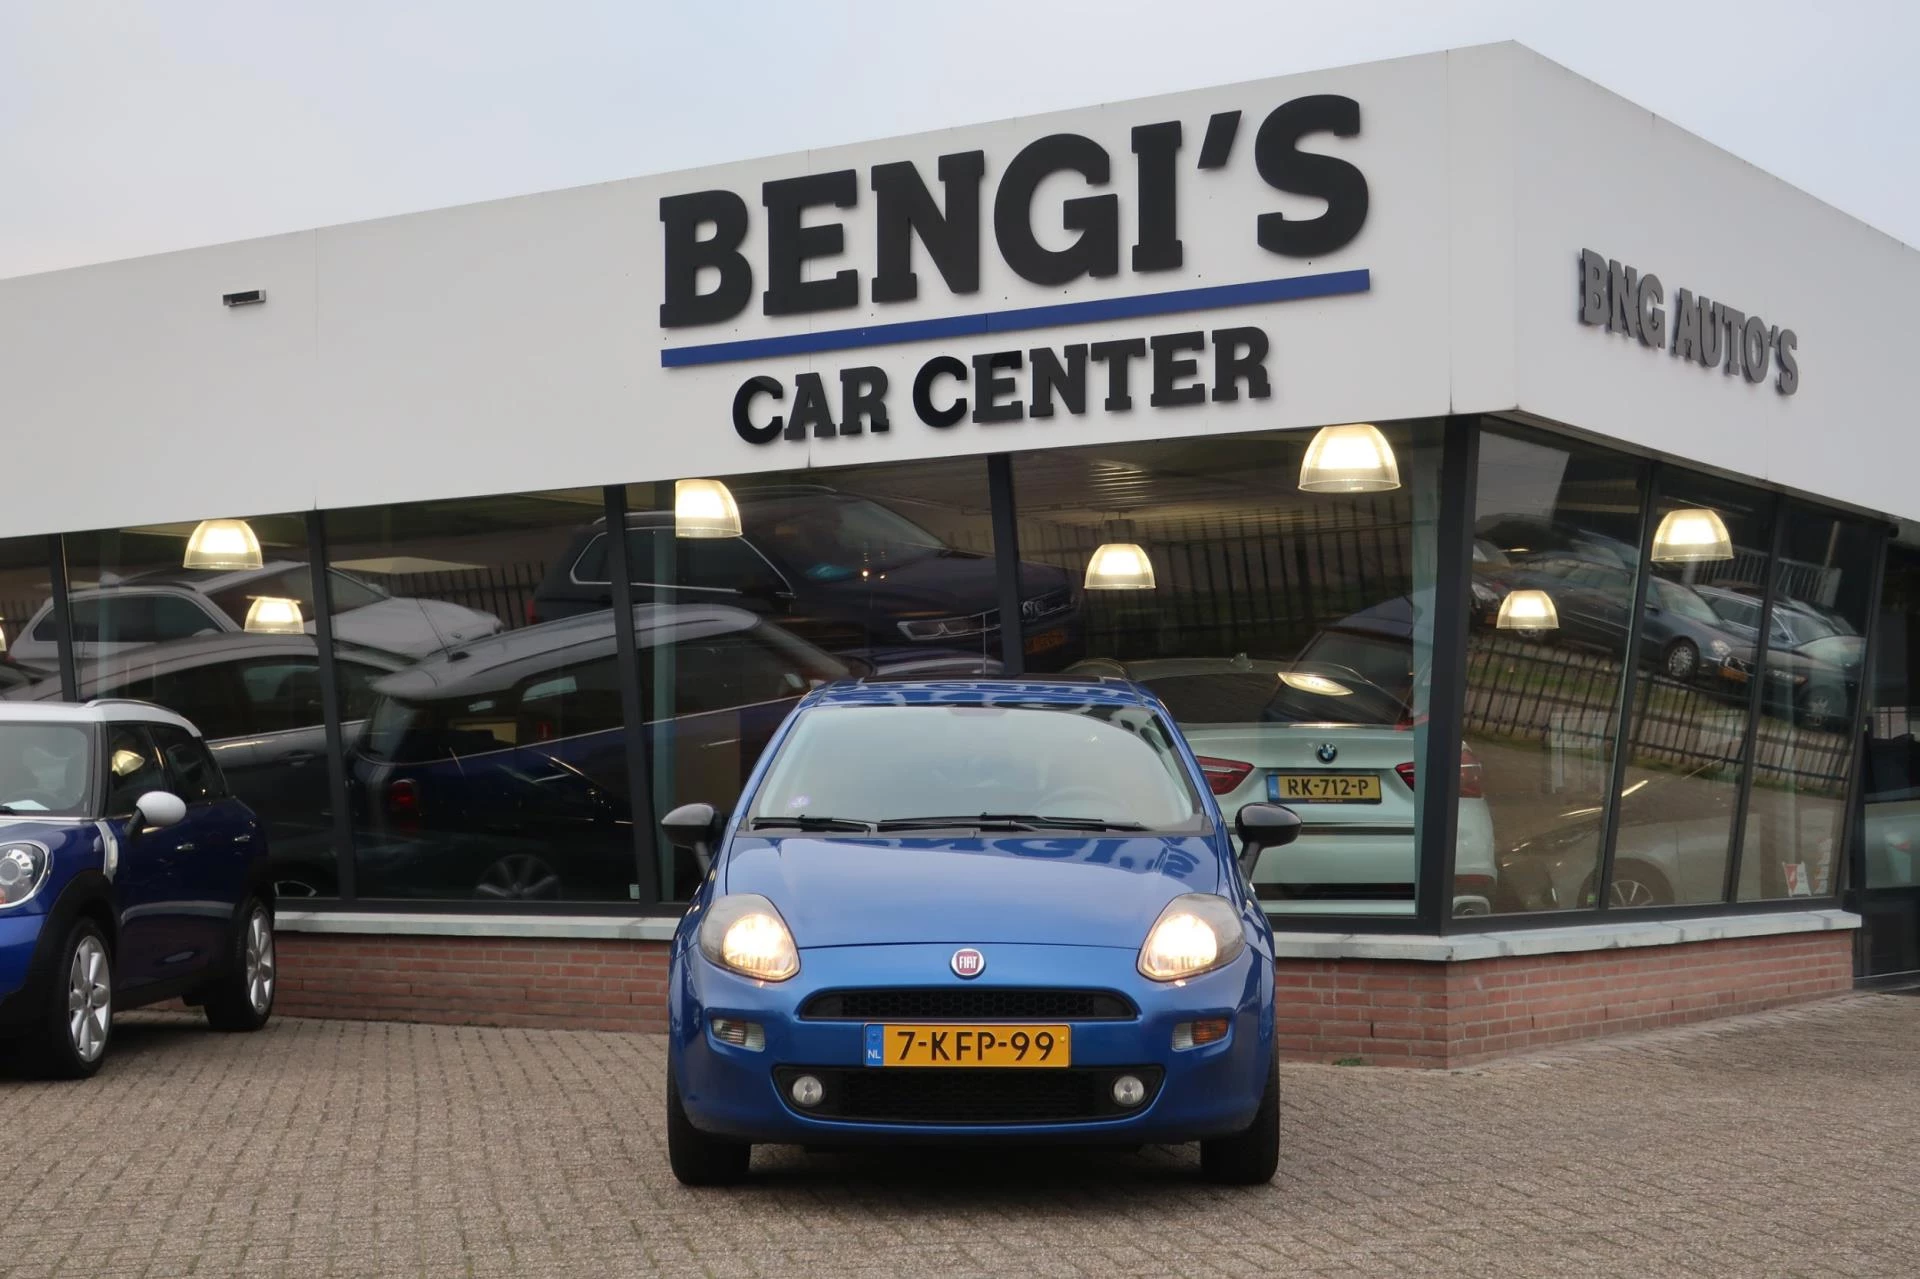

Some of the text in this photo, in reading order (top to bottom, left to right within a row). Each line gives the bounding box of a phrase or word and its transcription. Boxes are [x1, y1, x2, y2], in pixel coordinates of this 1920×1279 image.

[660, 94, 1369, 328] BENGI'S
[1579, 248, 1798, 395] BNG AUTO'S
[732, 326, 1271, 445] CAR CENTER
[1287, 778, 1369, 796] RK-712-P
[959, 955, 978, 969] FIAT
[867, 1031, 1054, 1061] NL 7-KFP-99
